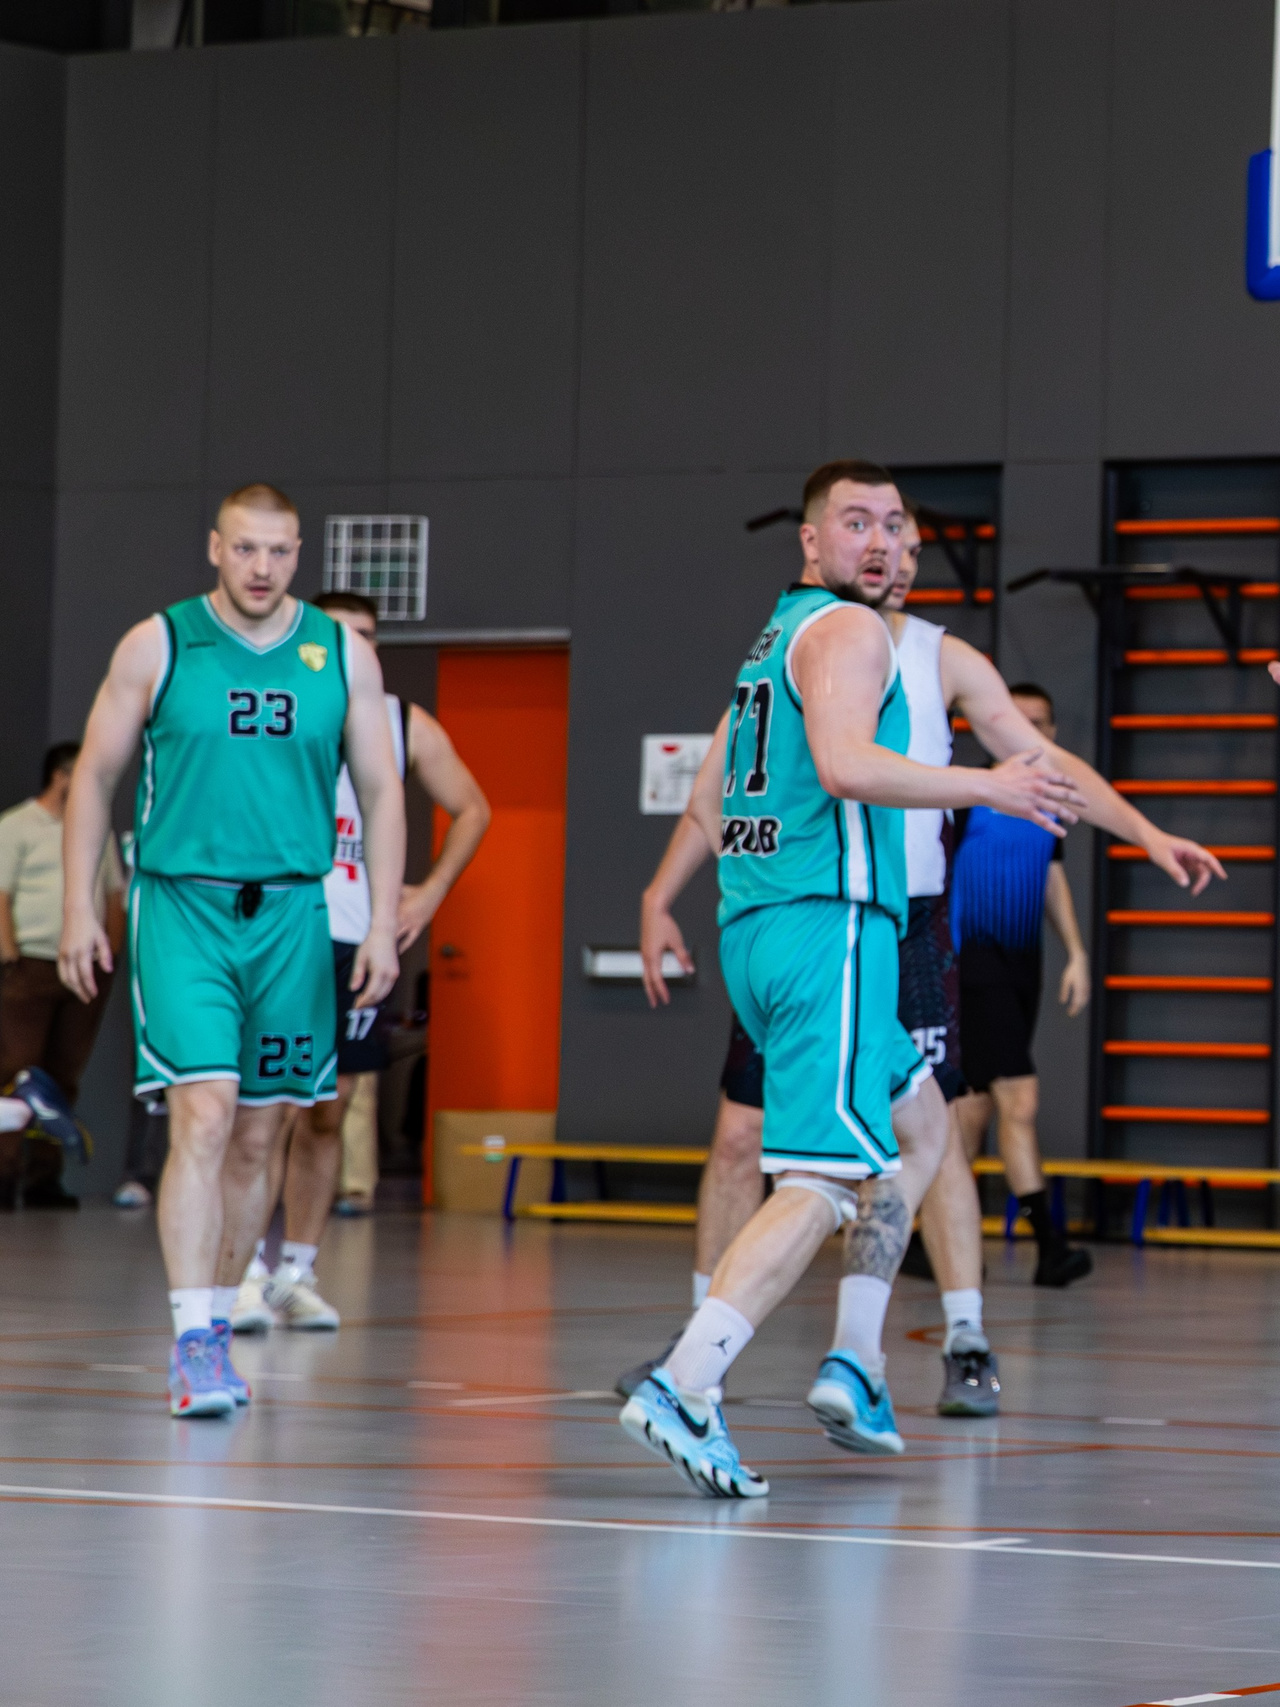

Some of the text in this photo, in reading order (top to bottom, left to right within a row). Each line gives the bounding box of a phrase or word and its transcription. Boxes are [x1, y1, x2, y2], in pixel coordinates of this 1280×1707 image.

[228, 688, 298, 740] 23
[345, 1006, 379, 1041] 17
[257, 1033, 314, 1080] 23
